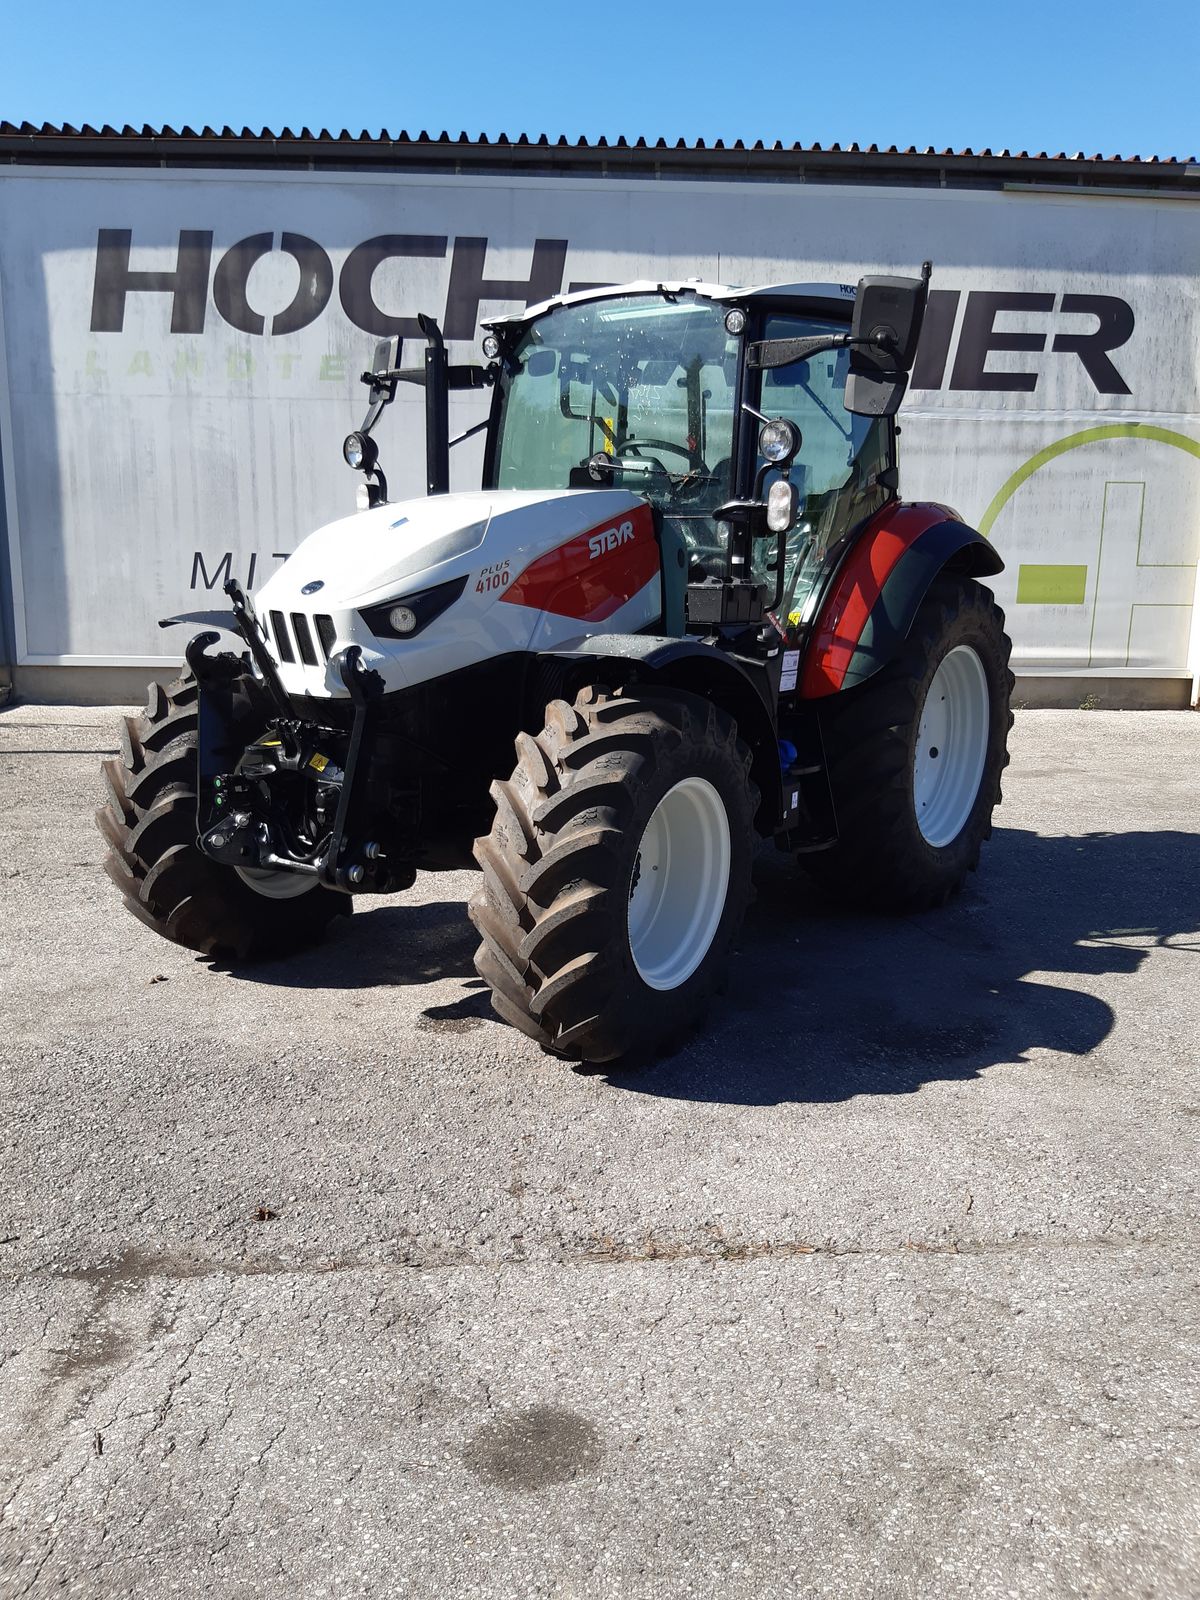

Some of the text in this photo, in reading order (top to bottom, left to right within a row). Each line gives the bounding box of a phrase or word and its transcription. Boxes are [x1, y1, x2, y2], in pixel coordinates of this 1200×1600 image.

[85, 350, 348, 382] LANDTE
[588, 521, 635, 560] STEYR
[480, 559, 510, 578] PLUS
[475, 571, 510, 594] 4100
